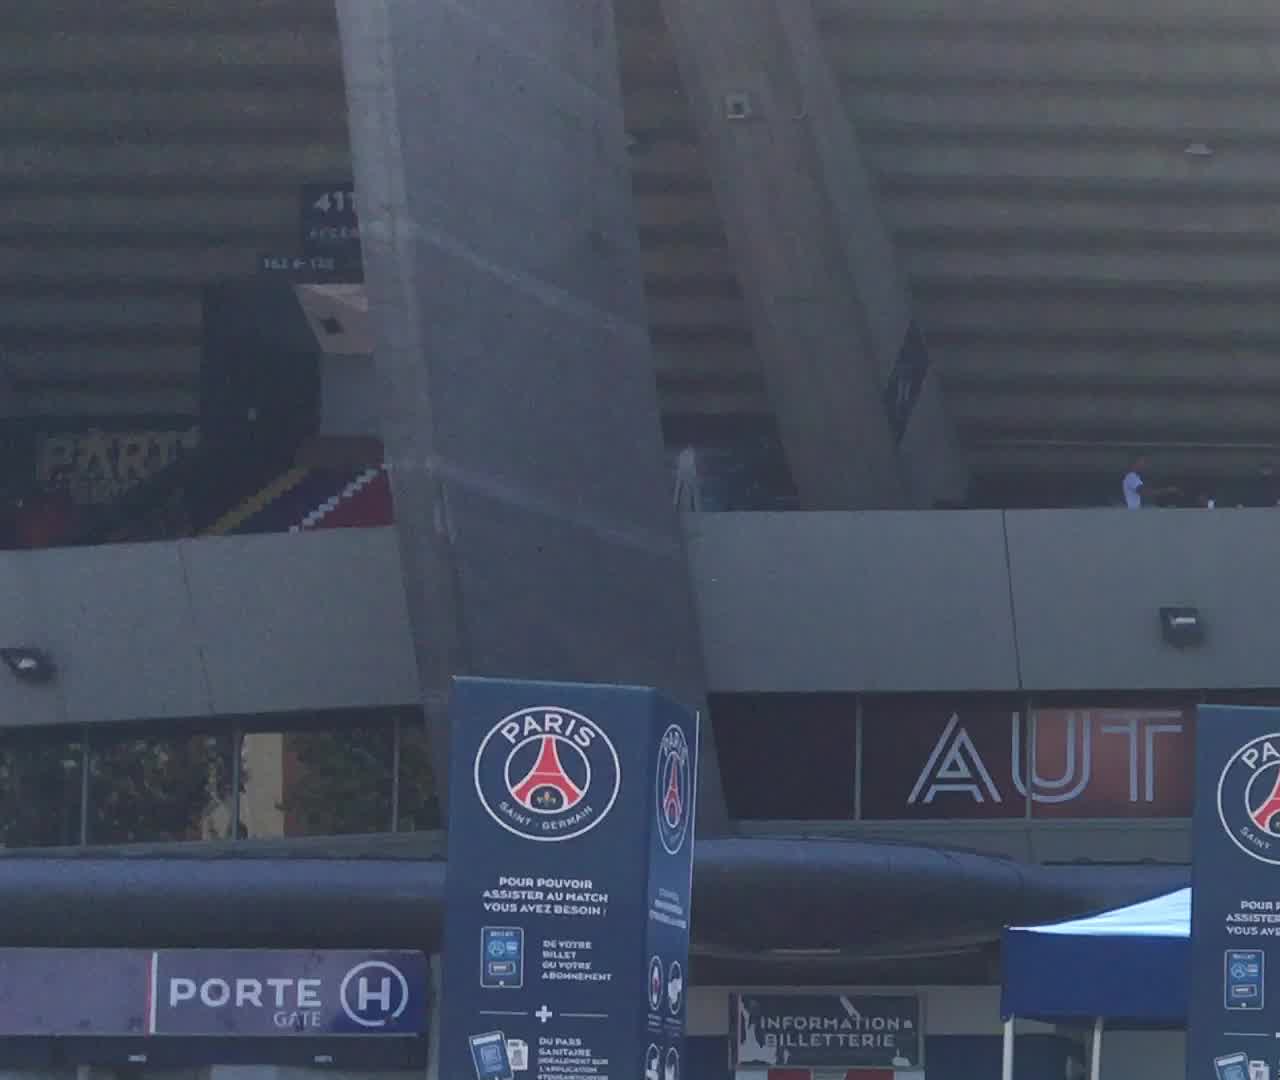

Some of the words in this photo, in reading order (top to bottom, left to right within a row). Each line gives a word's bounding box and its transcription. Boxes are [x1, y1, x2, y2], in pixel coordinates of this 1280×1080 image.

[500, 713, 596, 748] PARIS
[498, 800, 532, 826] SAINT
[542, 804, 594, 831] GERMAIN
[1239, 825, 1272, 850] SAINT
[499, 877, 534, 888] POUR
[536, 878, 593, 889] POUVOIR
[482, 889, 544, 901] ASSISTER
[546, 891, 563, 902] AU
[565, 891, 608, 903] MATCH
[483, 902, 517, 913] VOUS
[519, 903, 552, 914] AVEZ
[554, 904, 601, 916] BESOIN
[1240, 901, 1273, 911] POUR
[1225, 925, 1259, 935] VOUS
[169, 977, 322, 1008] PORTE
[358, 977, 391, 1011] H
[273, 1011, 321, 1027] GATE
[760, 1015, 900, 1031] INFORMATION
[764, 1033, 895, 1048] BILLETTERIE
